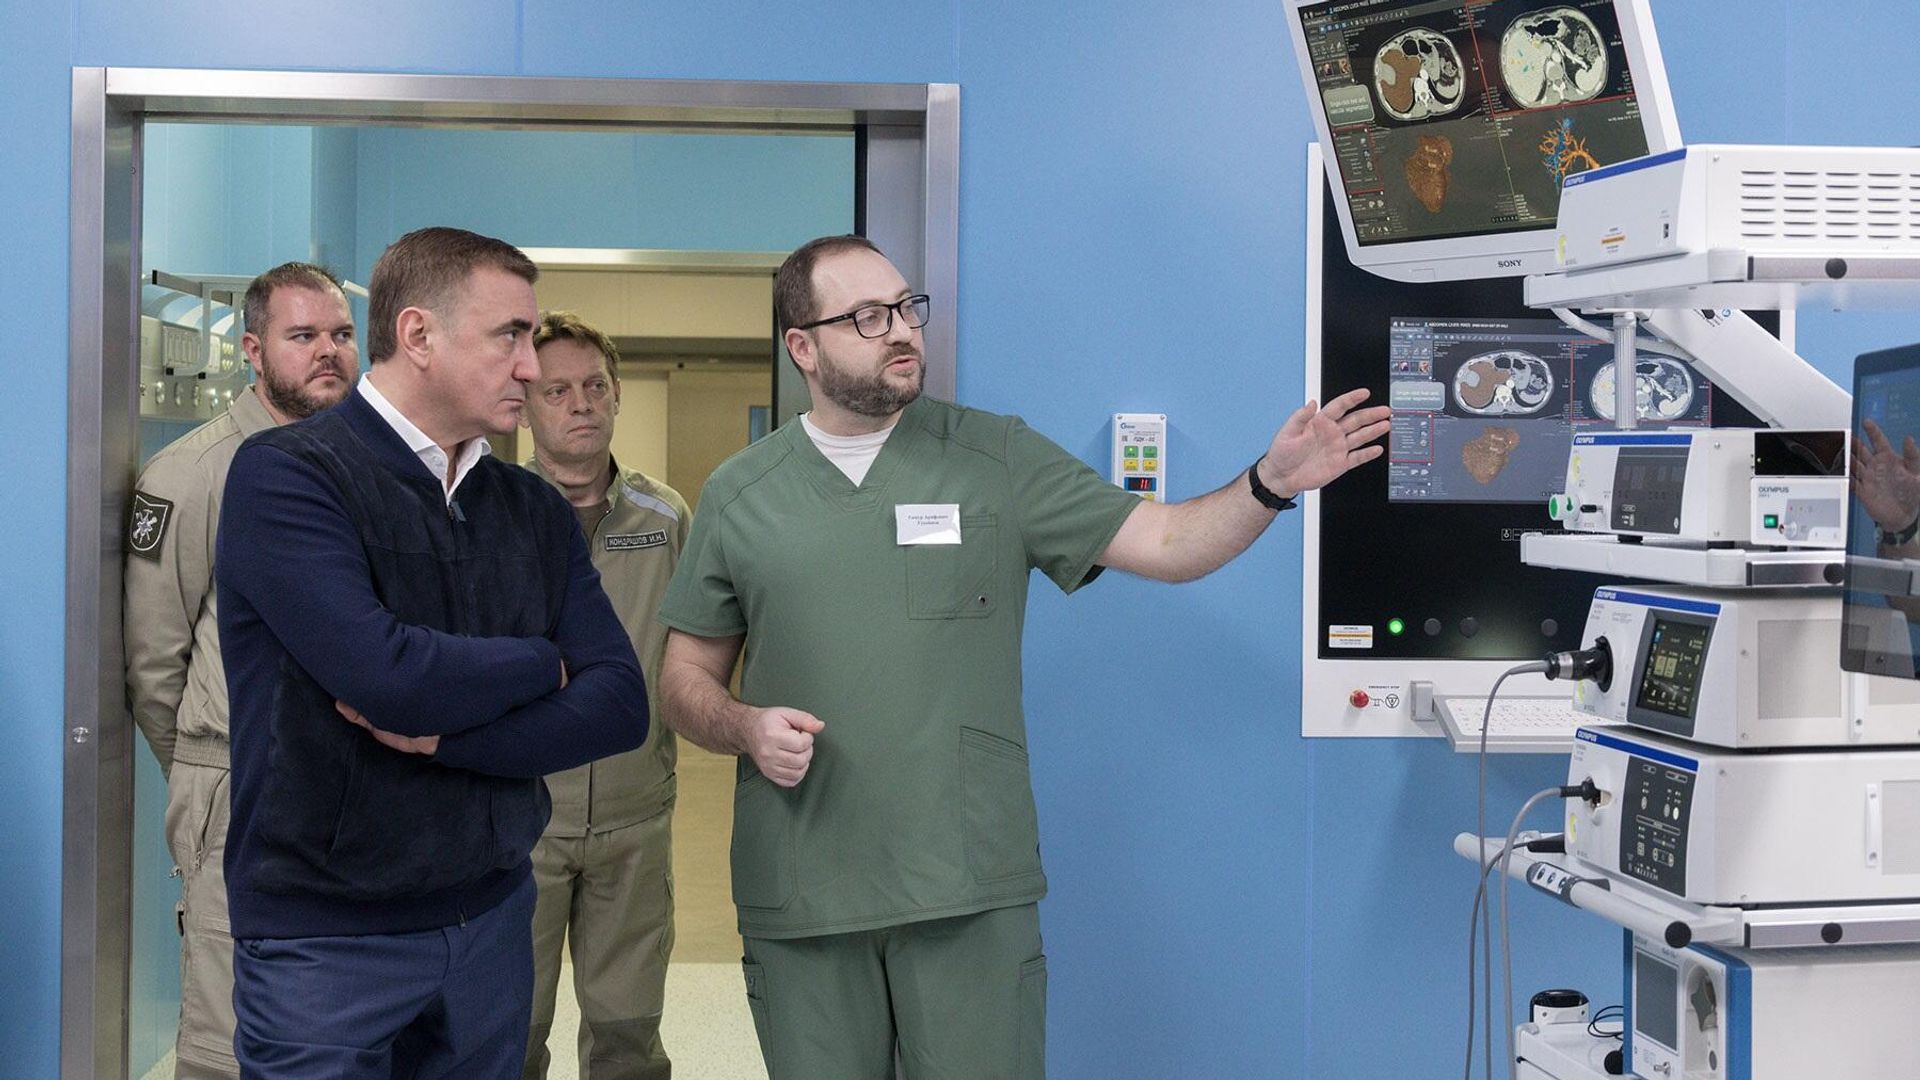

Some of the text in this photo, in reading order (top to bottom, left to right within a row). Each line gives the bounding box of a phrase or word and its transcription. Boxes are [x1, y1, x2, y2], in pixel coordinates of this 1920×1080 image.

[1498, 259, 1521, 268] SONY
[1758, 486, 1789, 494] OLYMPUS
[1577, 730, 1597, 743] OLYMPUS
